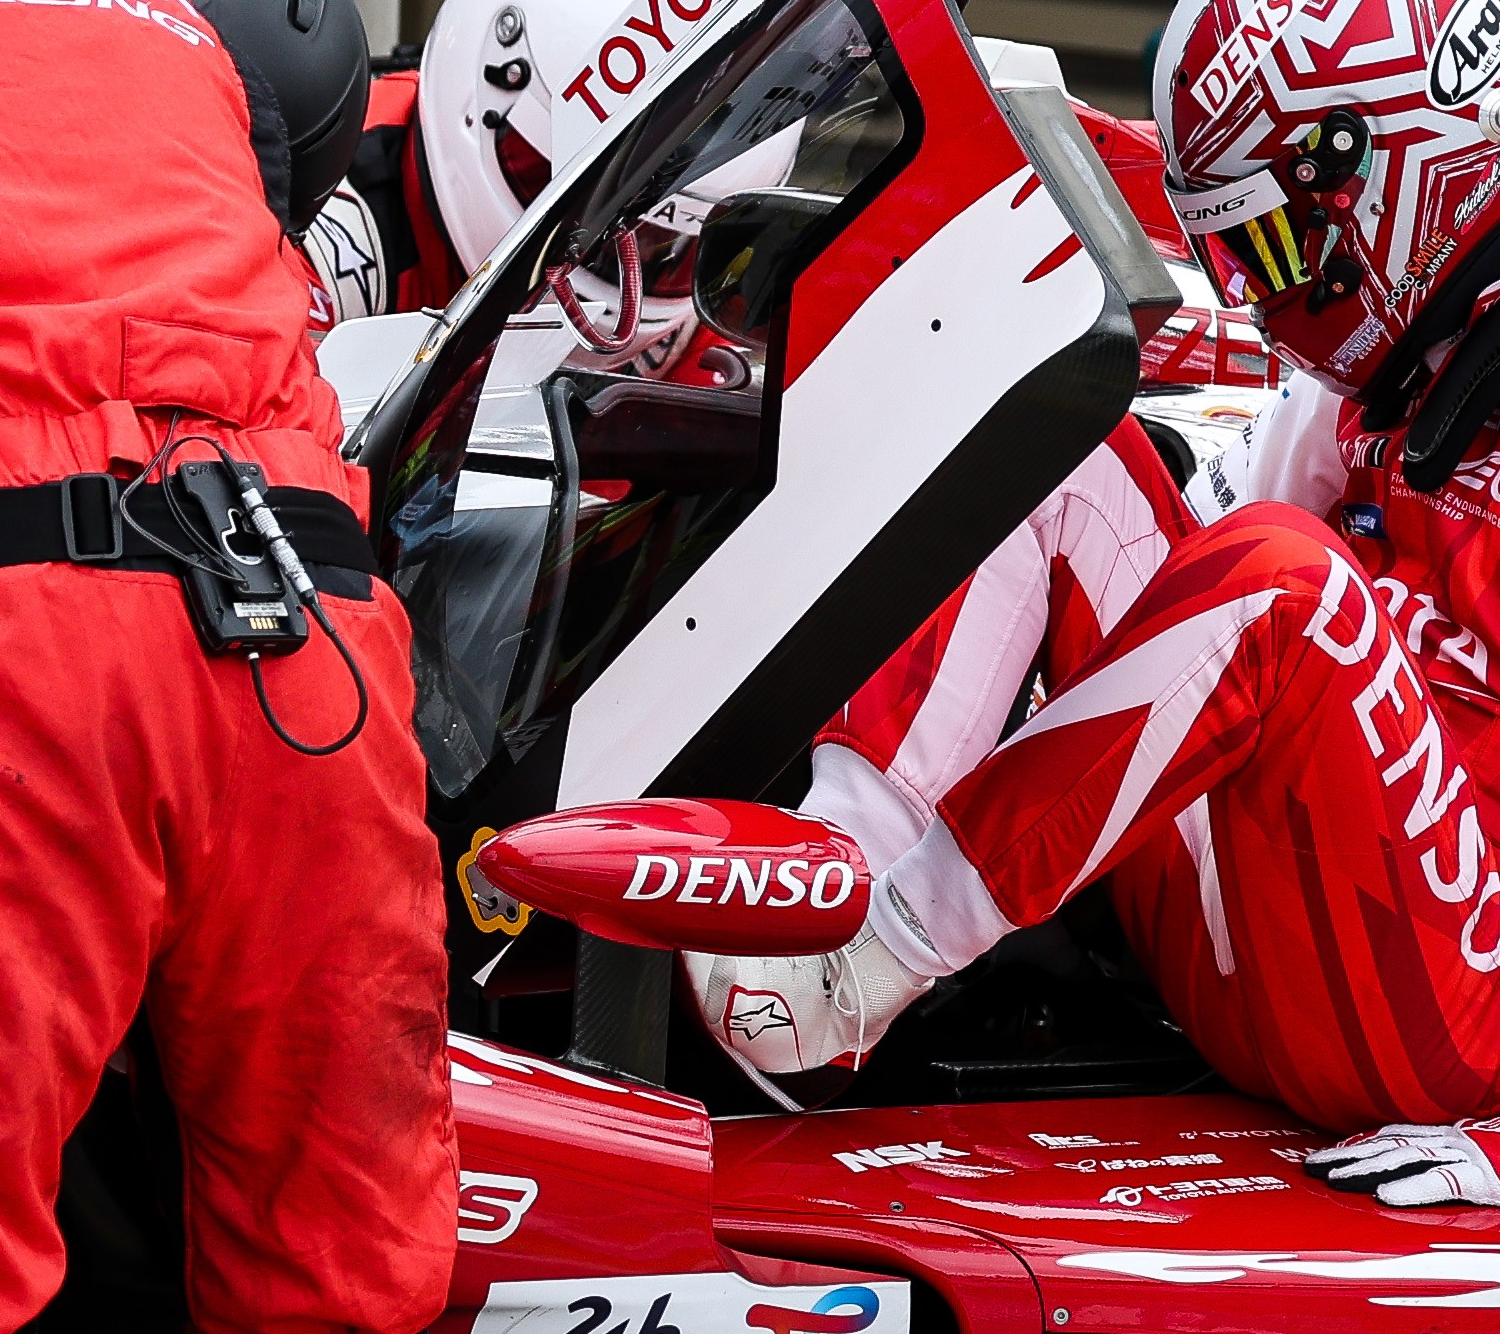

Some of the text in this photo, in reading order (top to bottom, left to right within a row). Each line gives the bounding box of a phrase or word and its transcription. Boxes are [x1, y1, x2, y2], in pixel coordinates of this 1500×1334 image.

[1405, 228, 1449, 277] SMILE
[1384, 273, 1414, 309] GOOD
[623, 854, 857, 909] DENSO
[832, 1141, 971, 1173] NSK
[1159, 1183, 1291, 1202] TOYOTA AUTO BODY
